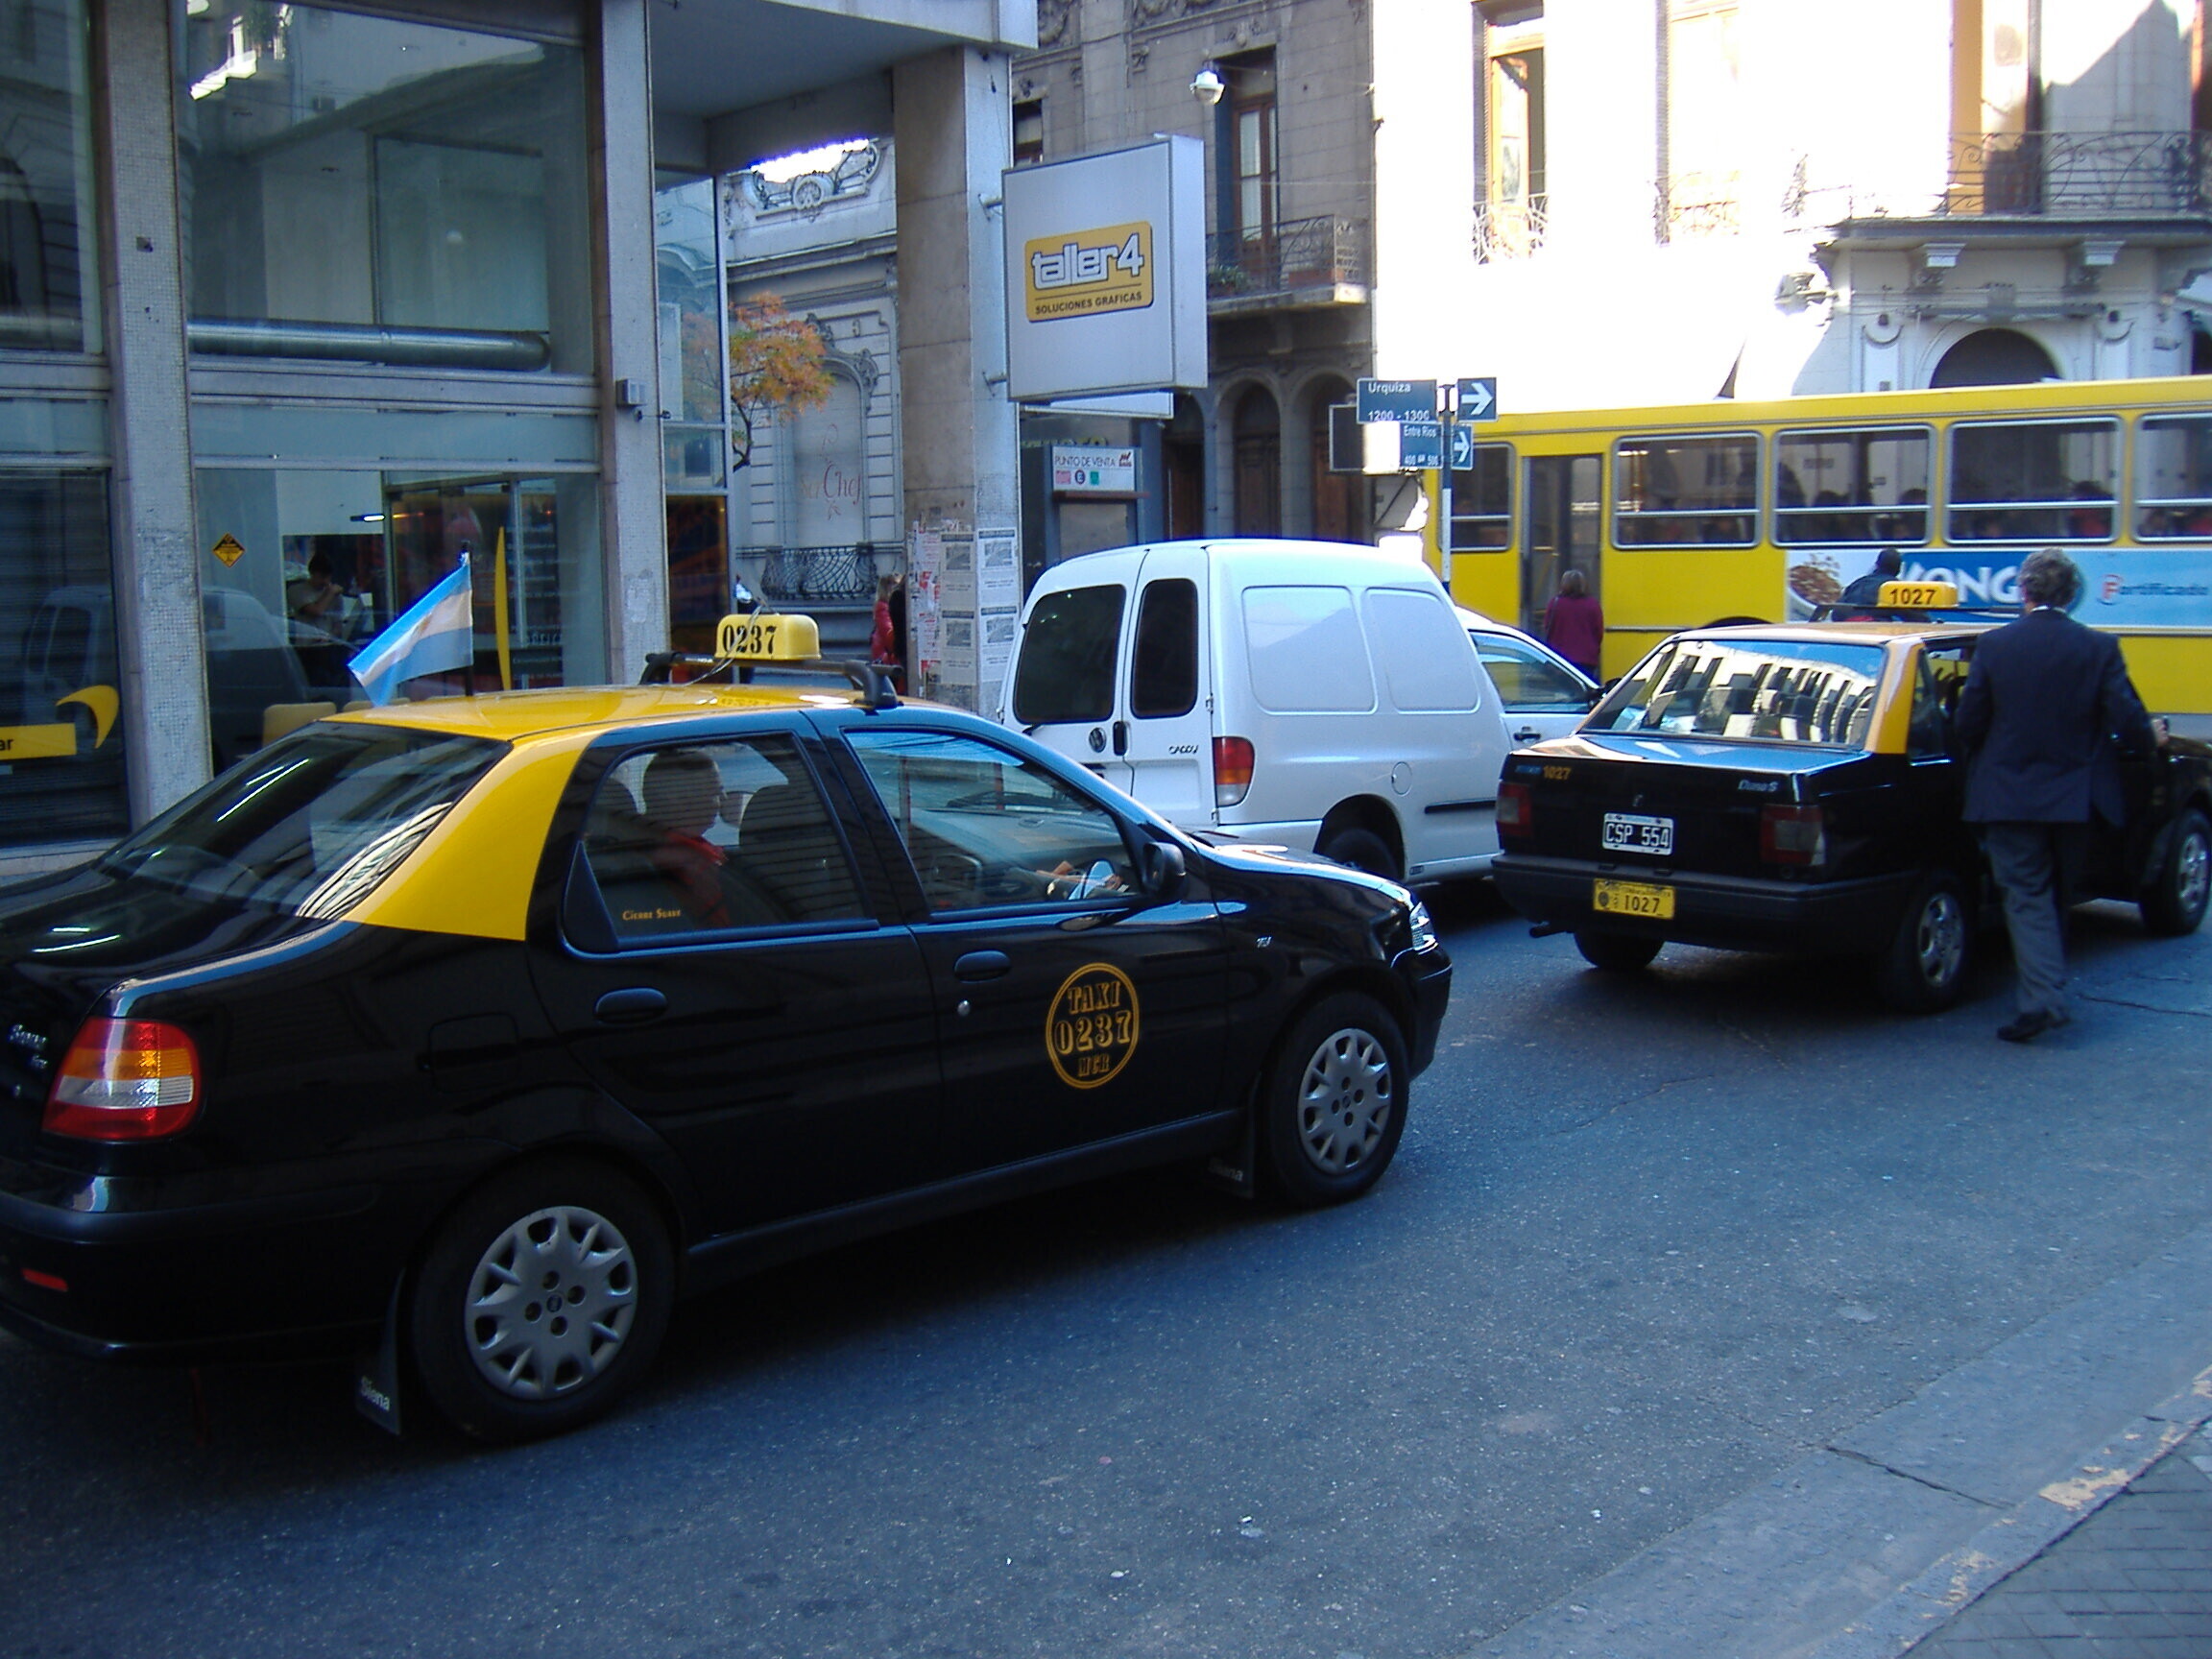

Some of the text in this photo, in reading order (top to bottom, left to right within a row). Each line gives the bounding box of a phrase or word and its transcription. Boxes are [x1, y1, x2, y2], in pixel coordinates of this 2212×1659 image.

[1031, 232, 1144, 290] taller4
[1035, 291, 1142, 315] SOLUCIONES GRAFICAS
[1368, 381, 1411, 395] Urquiza
[1368, 409, 1394, 421] 1200
[1404, 409, 1431, 421] 1300
[1404, 424, 1421, 437] Entre
[1055, 455, 1079, 467] PUNTO
[1081, 456, 1091, 467] DE
[1093, 456, 1116, 467] VENTA
[1889, 589, 1936, 605] 1027
[722, 624, 777, 655] 0237
[1543, 765, 1572, 781] 1027
[1605, 822, 1670, 848] CSP 554
[1623, 895, 1660, 913] 1027
[1067, 980, 1121, 1016] TAXI
[1055, 1009, 1132, 1055] 0237
